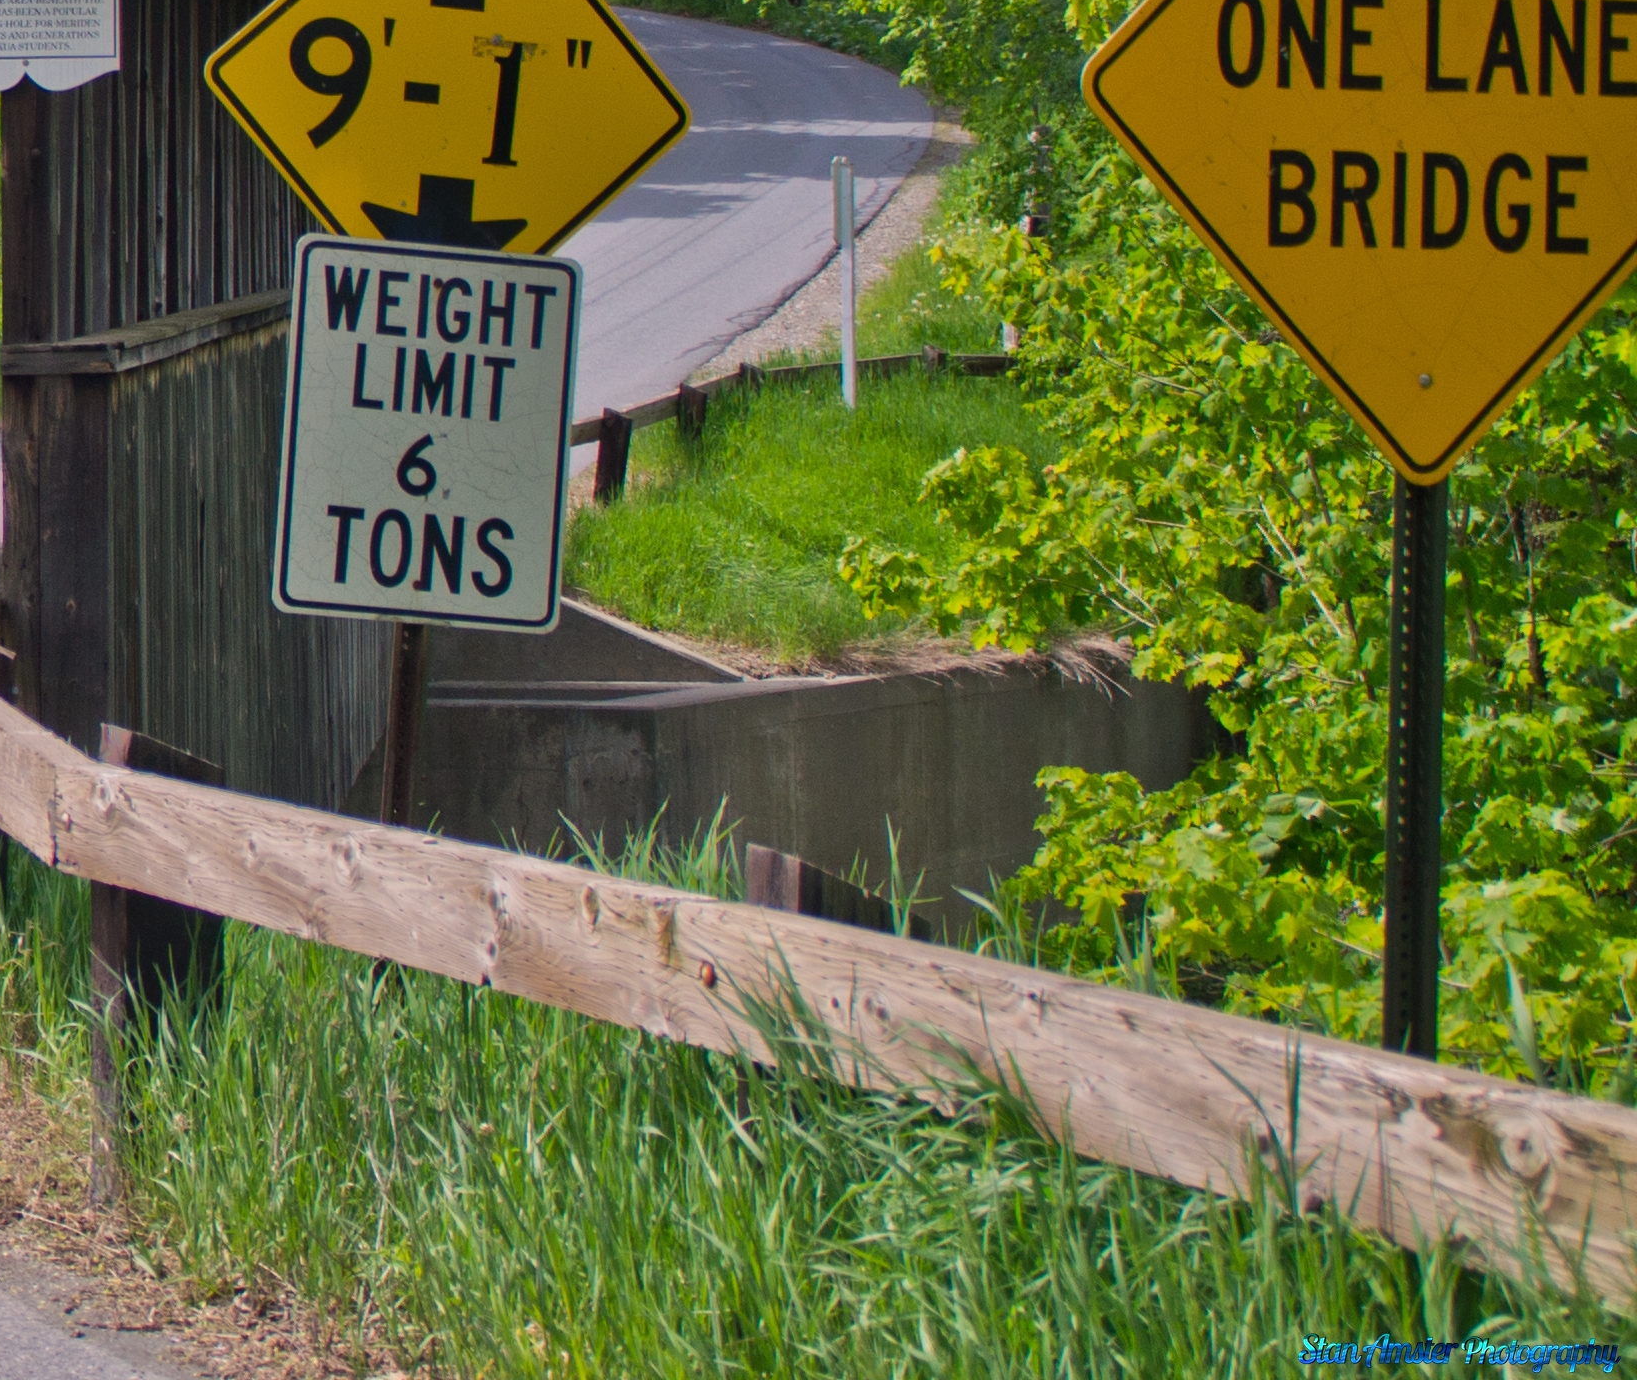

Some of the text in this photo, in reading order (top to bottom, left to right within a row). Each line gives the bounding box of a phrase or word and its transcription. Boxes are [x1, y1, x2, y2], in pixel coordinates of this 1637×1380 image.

[5, 19, 32, 28] HOLE
[35, 19, 53, 28] FOR
[56, 18, 101, 27] MERIDEN
[8, 31, 29, 40] AND
[31, 30, 100, 39] GENERATIONS
[15, 7, 41, 16] BEEN
[44, 7, 51, 16] A
[52, 7, 98, 16] POPULAR
[1267, 148, 1590, 256] BRIDGE
[324, 265, 558, 350] WEIGHT
[352, 342, 516, 422] LIMIT
[396, 433, 438, 497] 6
[327, 504, 515, 598] TONS
